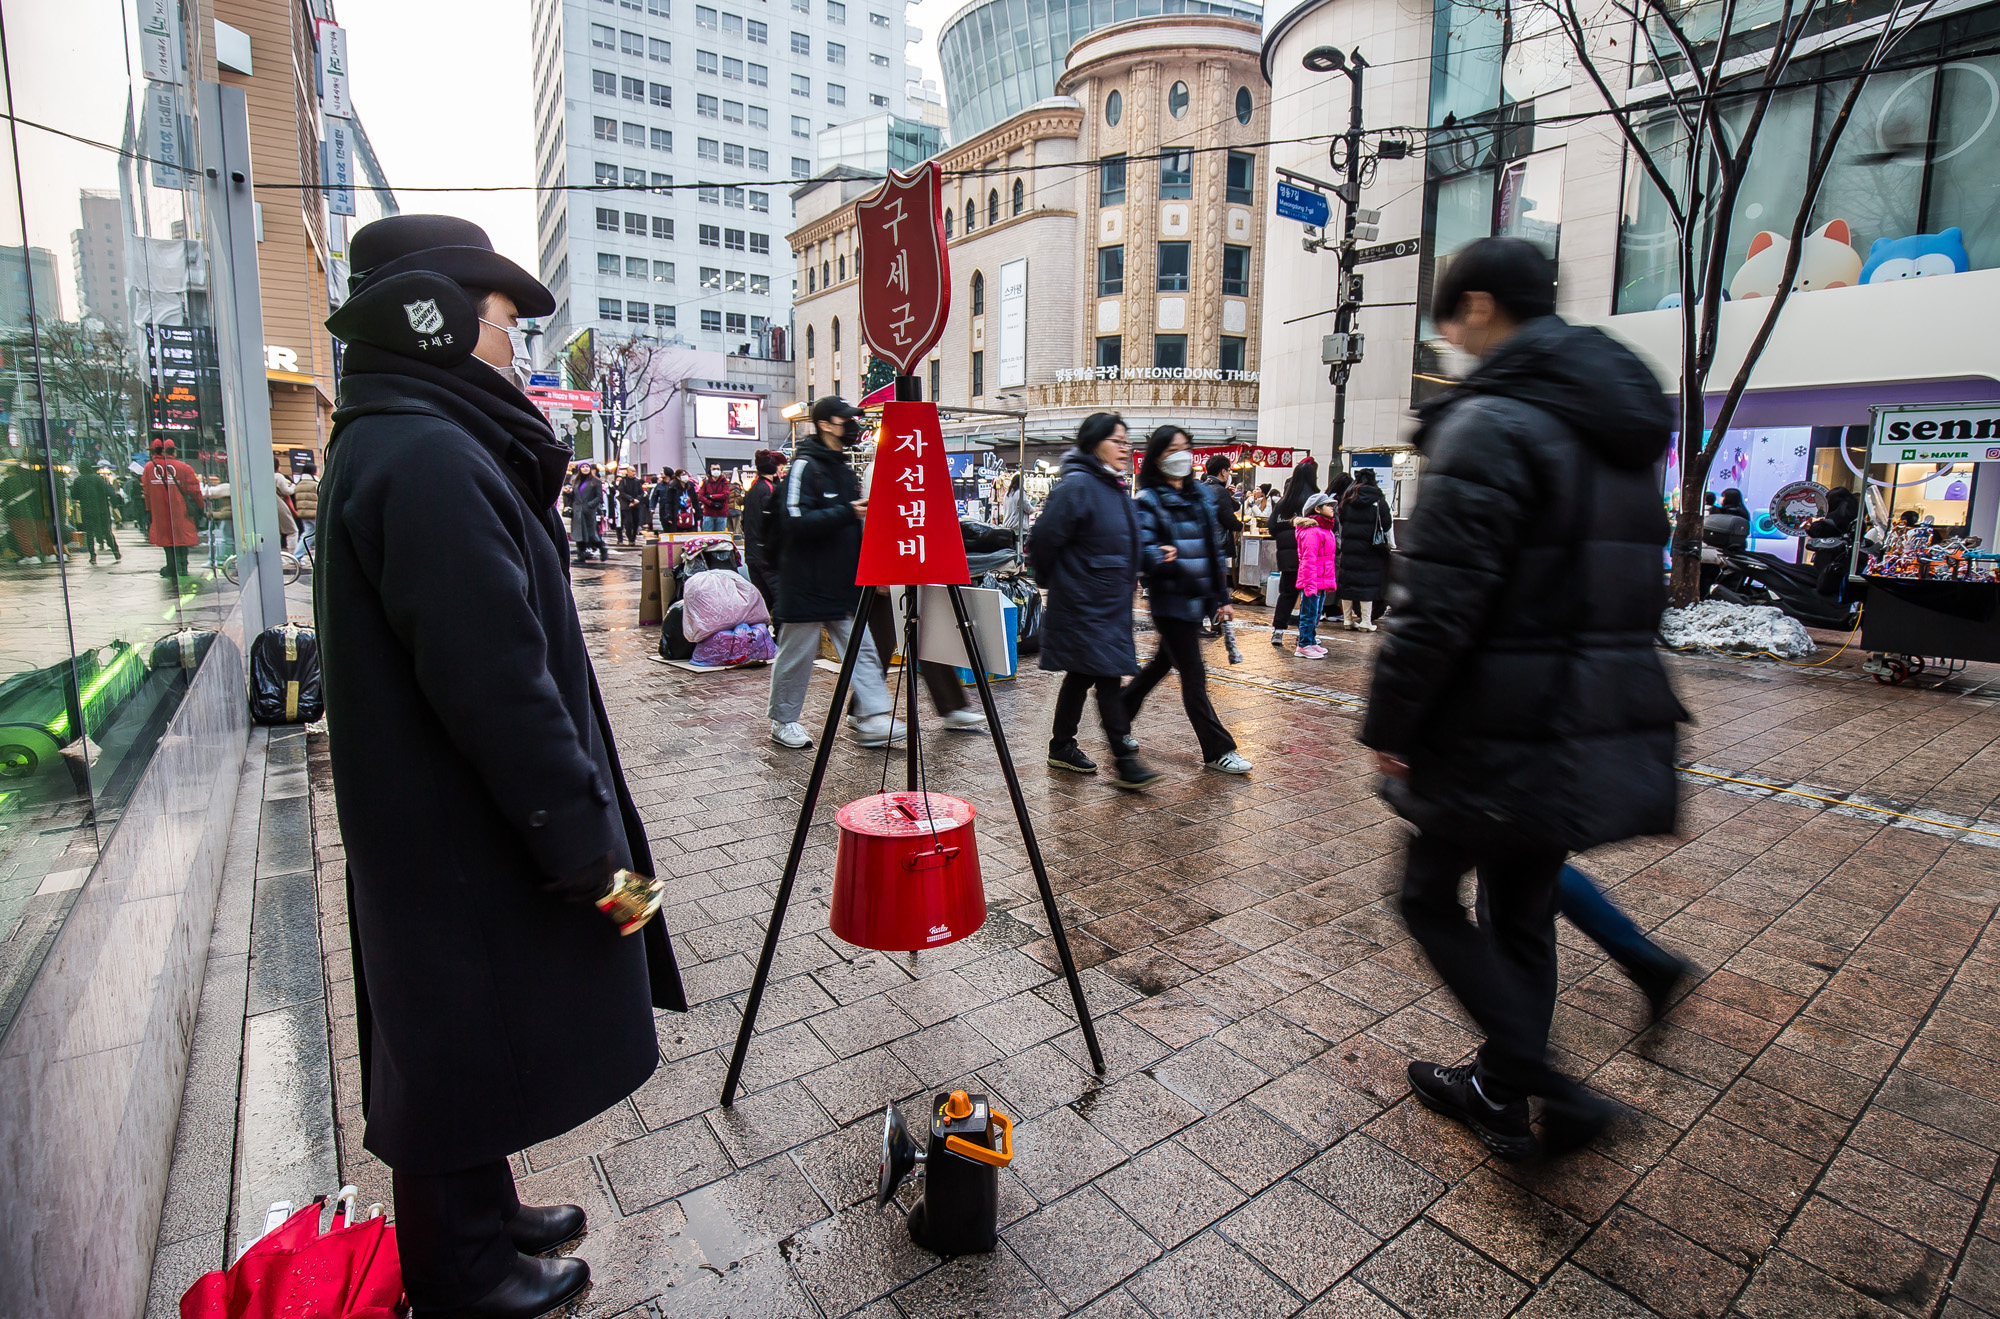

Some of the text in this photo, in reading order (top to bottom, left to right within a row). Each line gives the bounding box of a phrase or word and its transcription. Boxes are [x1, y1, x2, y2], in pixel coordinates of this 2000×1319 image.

[1280, 186, 1299, 201] 명동7길
[882, 197, 915, 346] 구세군
[412, 303, 424, 316] THE
[417, 333, 454, 351] 구세군
[263, 344, 299, 373] R
[1055, 365, 1120, 382] 명동예술극장
[1124, 367, 1260, 382] MYEONGDONG THEA
[1931, 451, 1968, 459] NAVER
[894, 429, 929, 564] 자선냄비
